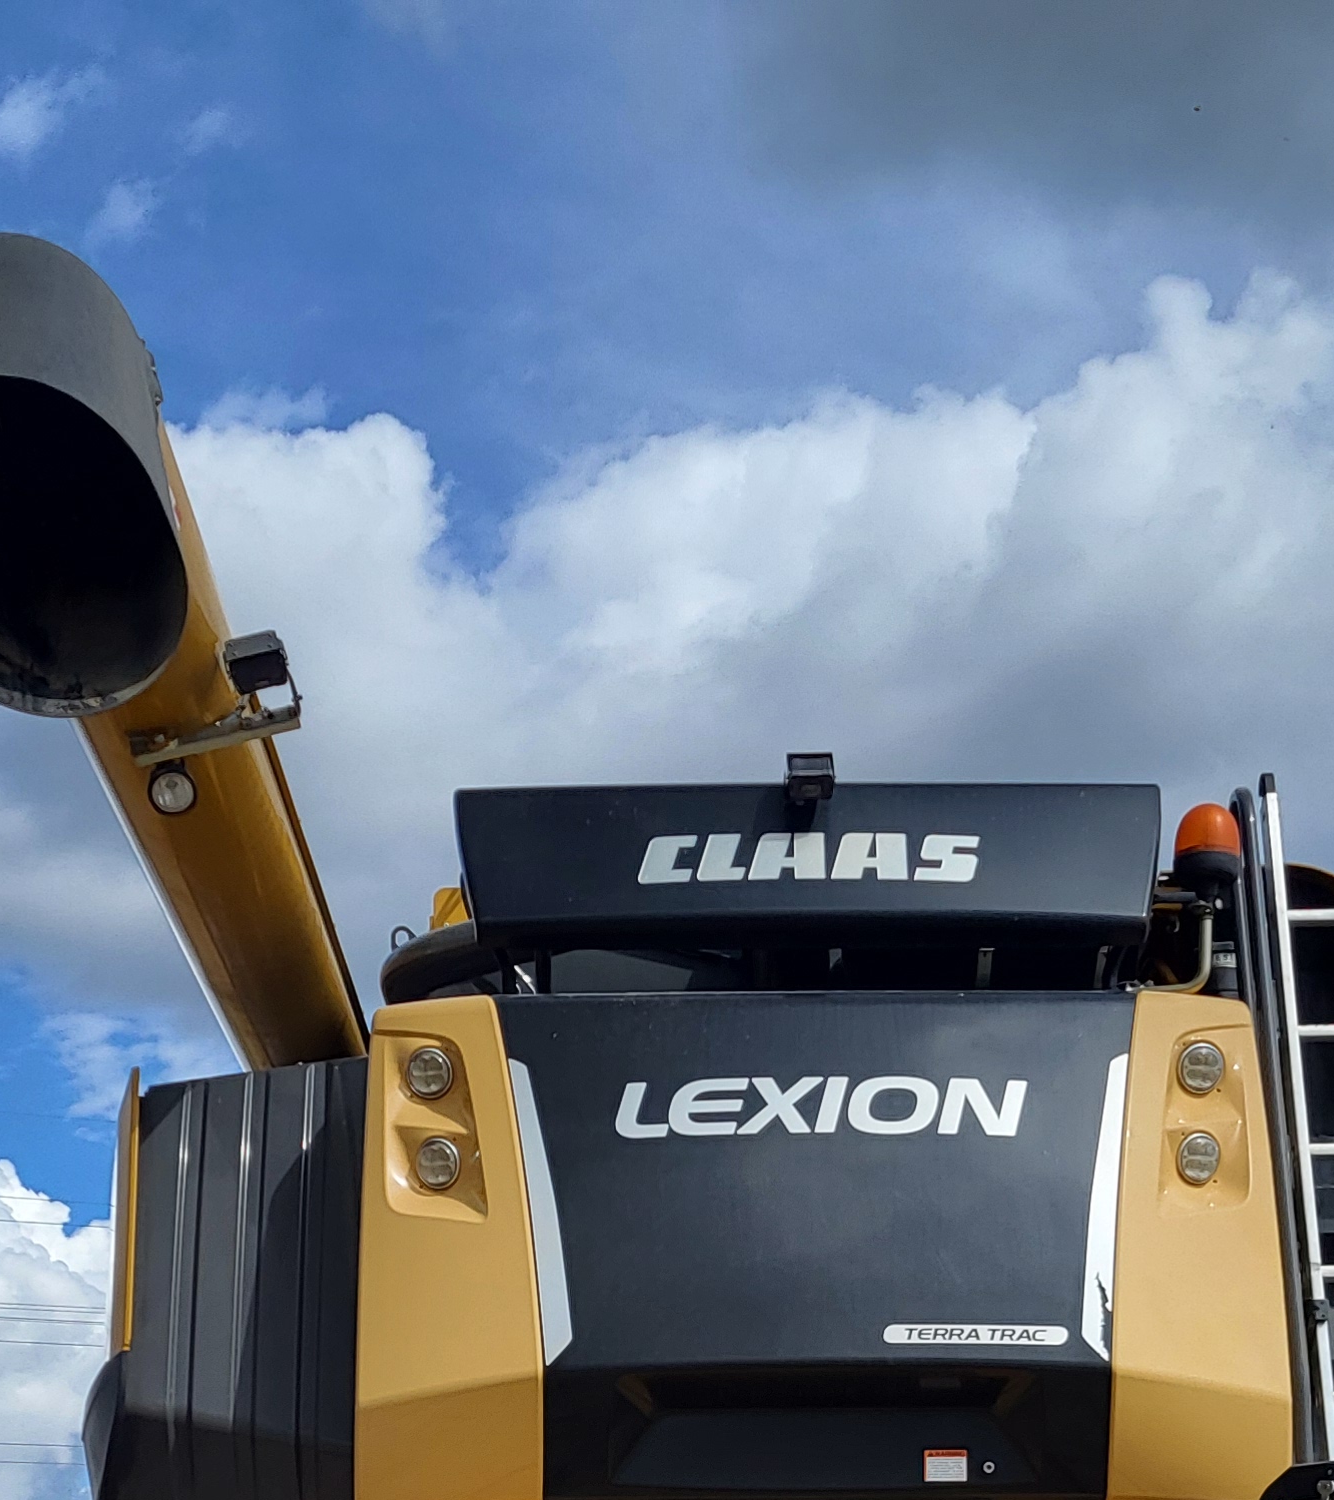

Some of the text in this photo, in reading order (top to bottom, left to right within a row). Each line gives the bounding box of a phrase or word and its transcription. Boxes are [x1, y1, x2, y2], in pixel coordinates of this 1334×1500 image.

[637, 832, 981, 885] CLAAS
[615, 1075, 1028, 1139] LEXION
[904, 1327, 1047, 1342] TERRA TRAC
